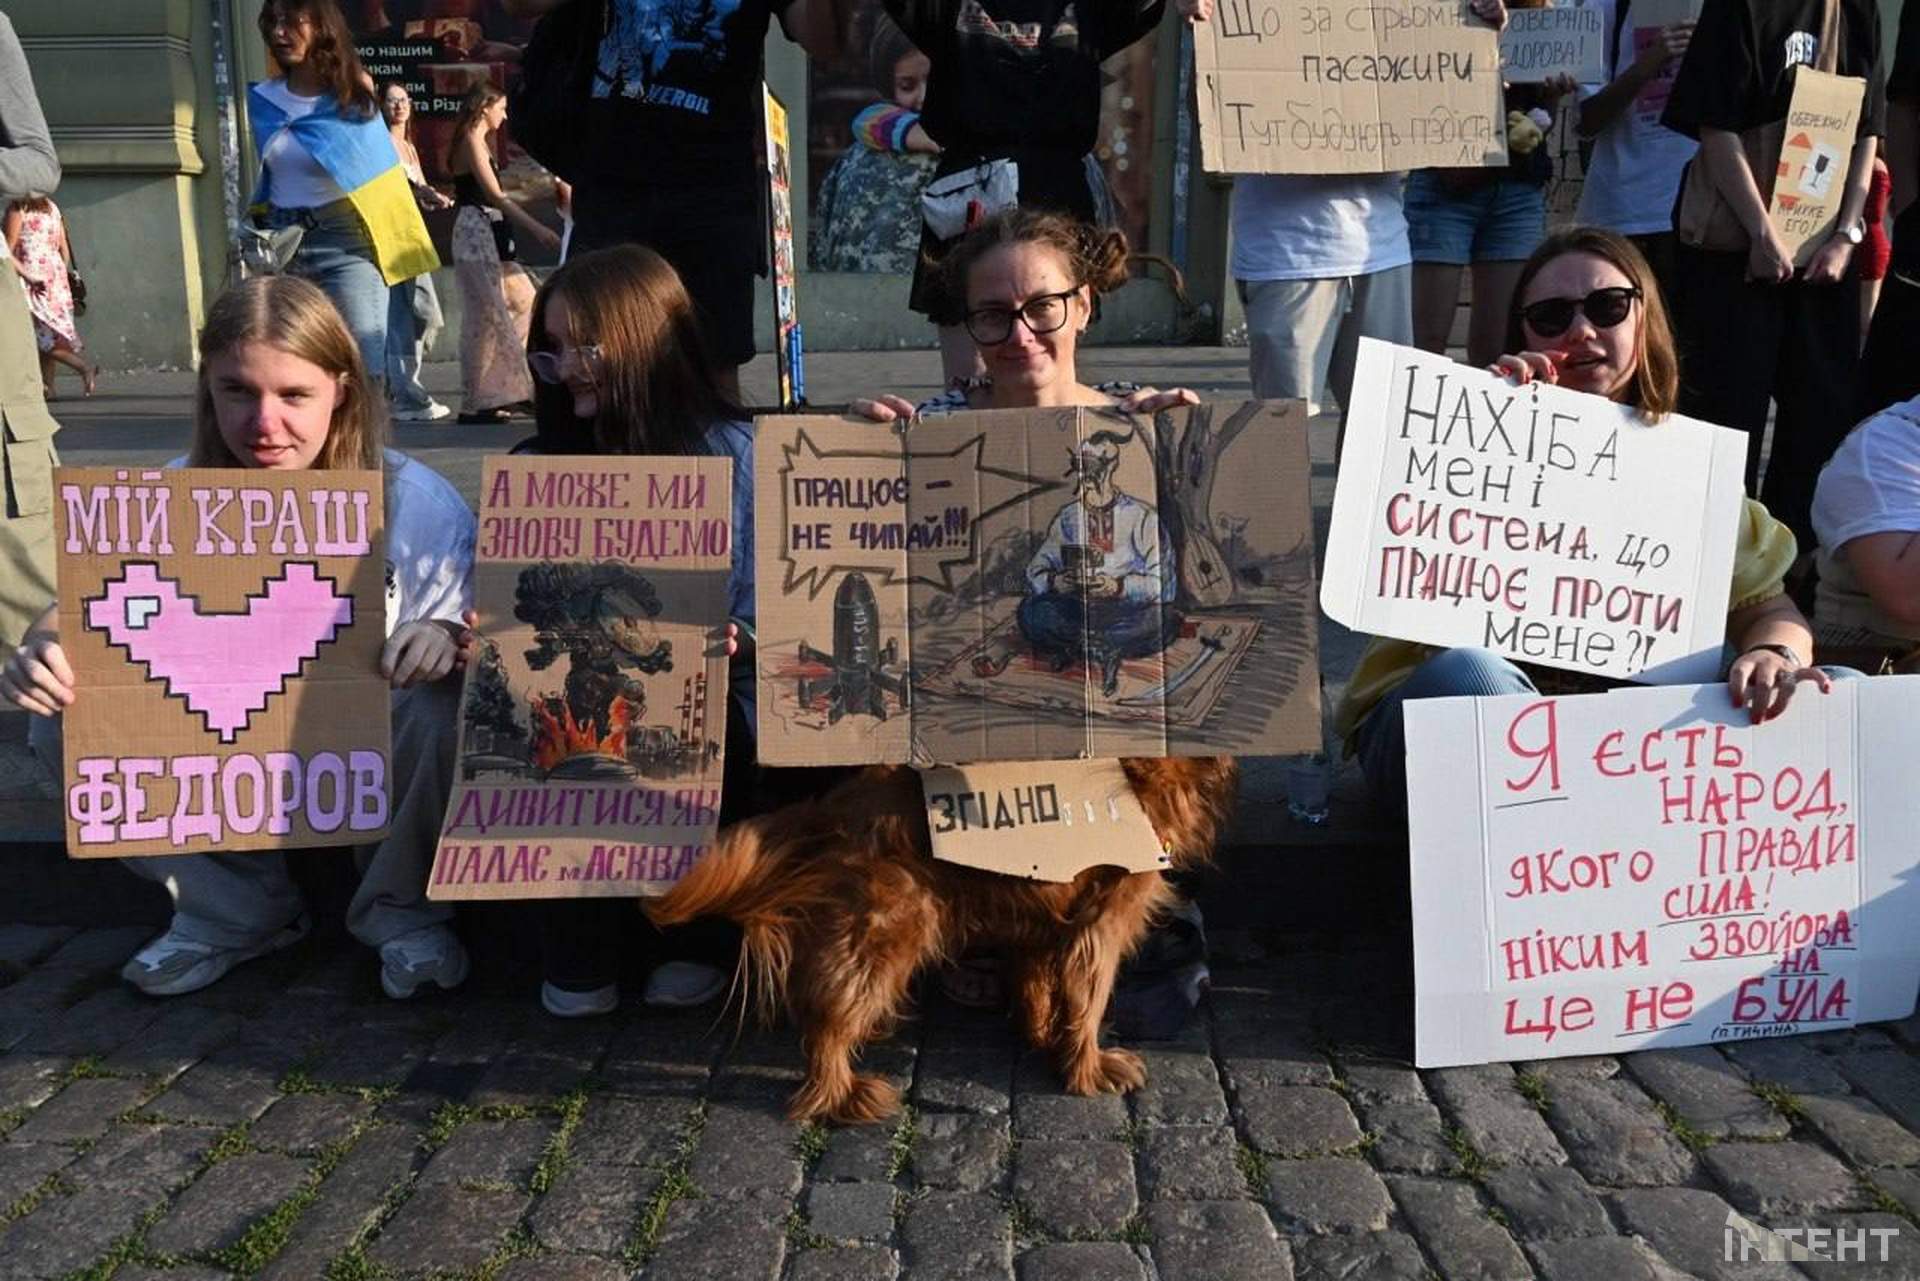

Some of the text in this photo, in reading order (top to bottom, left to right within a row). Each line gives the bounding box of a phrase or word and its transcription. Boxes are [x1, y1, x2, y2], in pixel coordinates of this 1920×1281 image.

[1218, 0, 1462, 43] Що за стрьомн
[379, 45, 433, 57] нашим
[61, 469, 372, 556] МІЙ КРАШ
[487, 469, 707, 510] А МОЖЕ МИ
[793, 476, 911, 511] ПРАЦЮЄ
[481, 516, 729, 563] ЗНОВУ БУДЕМО
[792, 523, 832, 551] НЕ
[1377, 546, 1684, 635] ПРАЦЮЄ ПРОТИ
[1506, 700, 1561, 793] Я
[68, 749, 390, 846] ФЕДОРОВ
[443, 786, 719, 837] ДИВИТИСЯ ЯК
[931, 783, 1061, 834] ЗГІДНО
[1659, 766, 1848, 826] НАРОД,
[1700, 823, 1856, 879] ПРАВДИ
[1664, 872, 1774, 920] СИЛА!
[1731, 976, 1853, 1023] БУЛА
